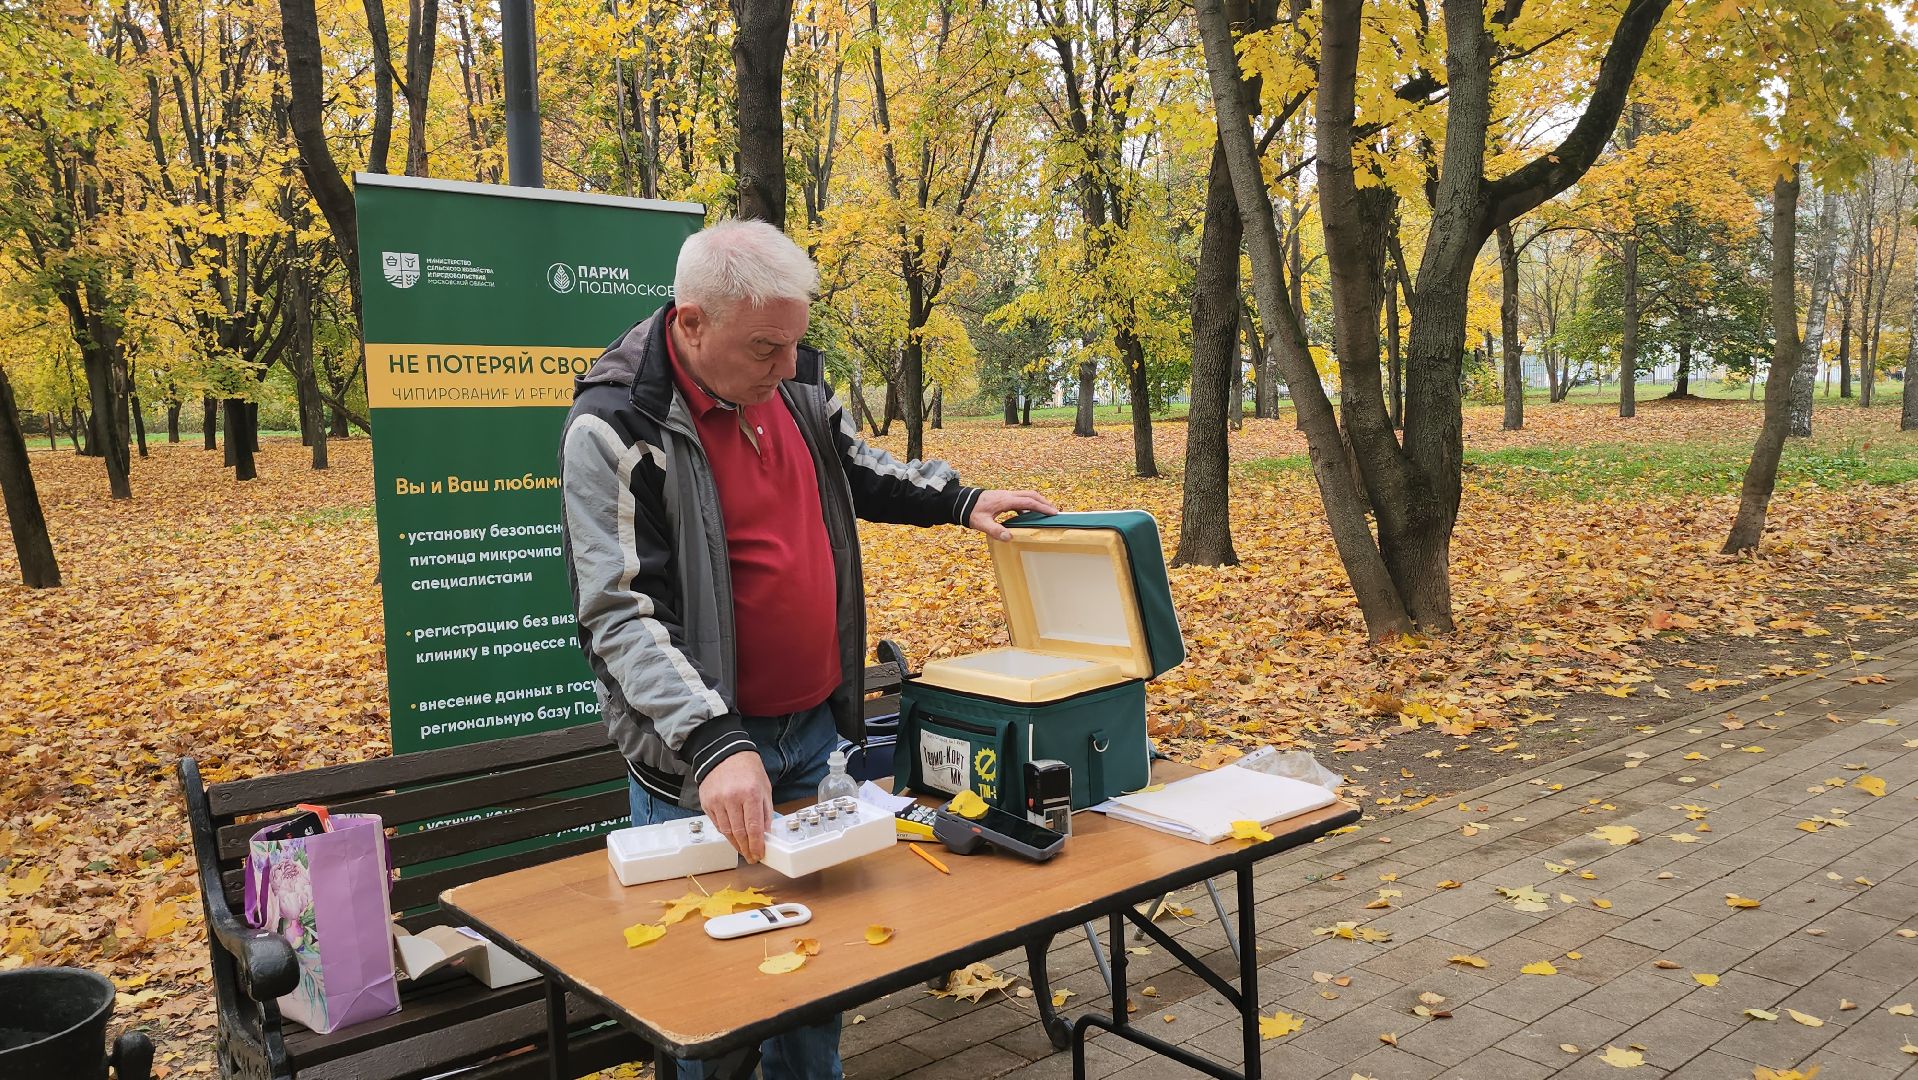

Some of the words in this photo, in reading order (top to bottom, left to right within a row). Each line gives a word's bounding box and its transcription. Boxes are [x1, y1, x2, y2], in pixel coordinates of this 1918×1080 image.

[578, 266, 630, 280] ПАРКИ
[389, 355, 419, 374] НЕ
[426, 351, 534, 375] ПОТЕРЯЙ
[392, 387, 509, 401] ЧИПИРОВАНИЕ
[515, 388, 525, 400] И
[396, 477, 425, 495] Вы
[431, 480, 442, 493] и
[447, 476, 489, 494] Ваш
[408, 527, 487, 545] установку
[489, 523, 563, 538] безопасн
[409, 551, 476, 567] питомца
[479, 546, 562, 563] микрочипа
[411, 570, 533, 591] специалистами
[414, 619, 519, 643] регистрацию
[522, 614, 548, 628] без
[551, 613, 578, 625] виз
[416, 644, 477, 664] клинику
[481, 644, 490, 656] в
[493, 637, 566, 657] процессе
[419, 694, 491, 712] внесение
[495, 685, 552, 704] данных
[556, 684, 564, 695] в
[420, 711, 534, 739] региональную
[537, 704, 571, 721] базу
